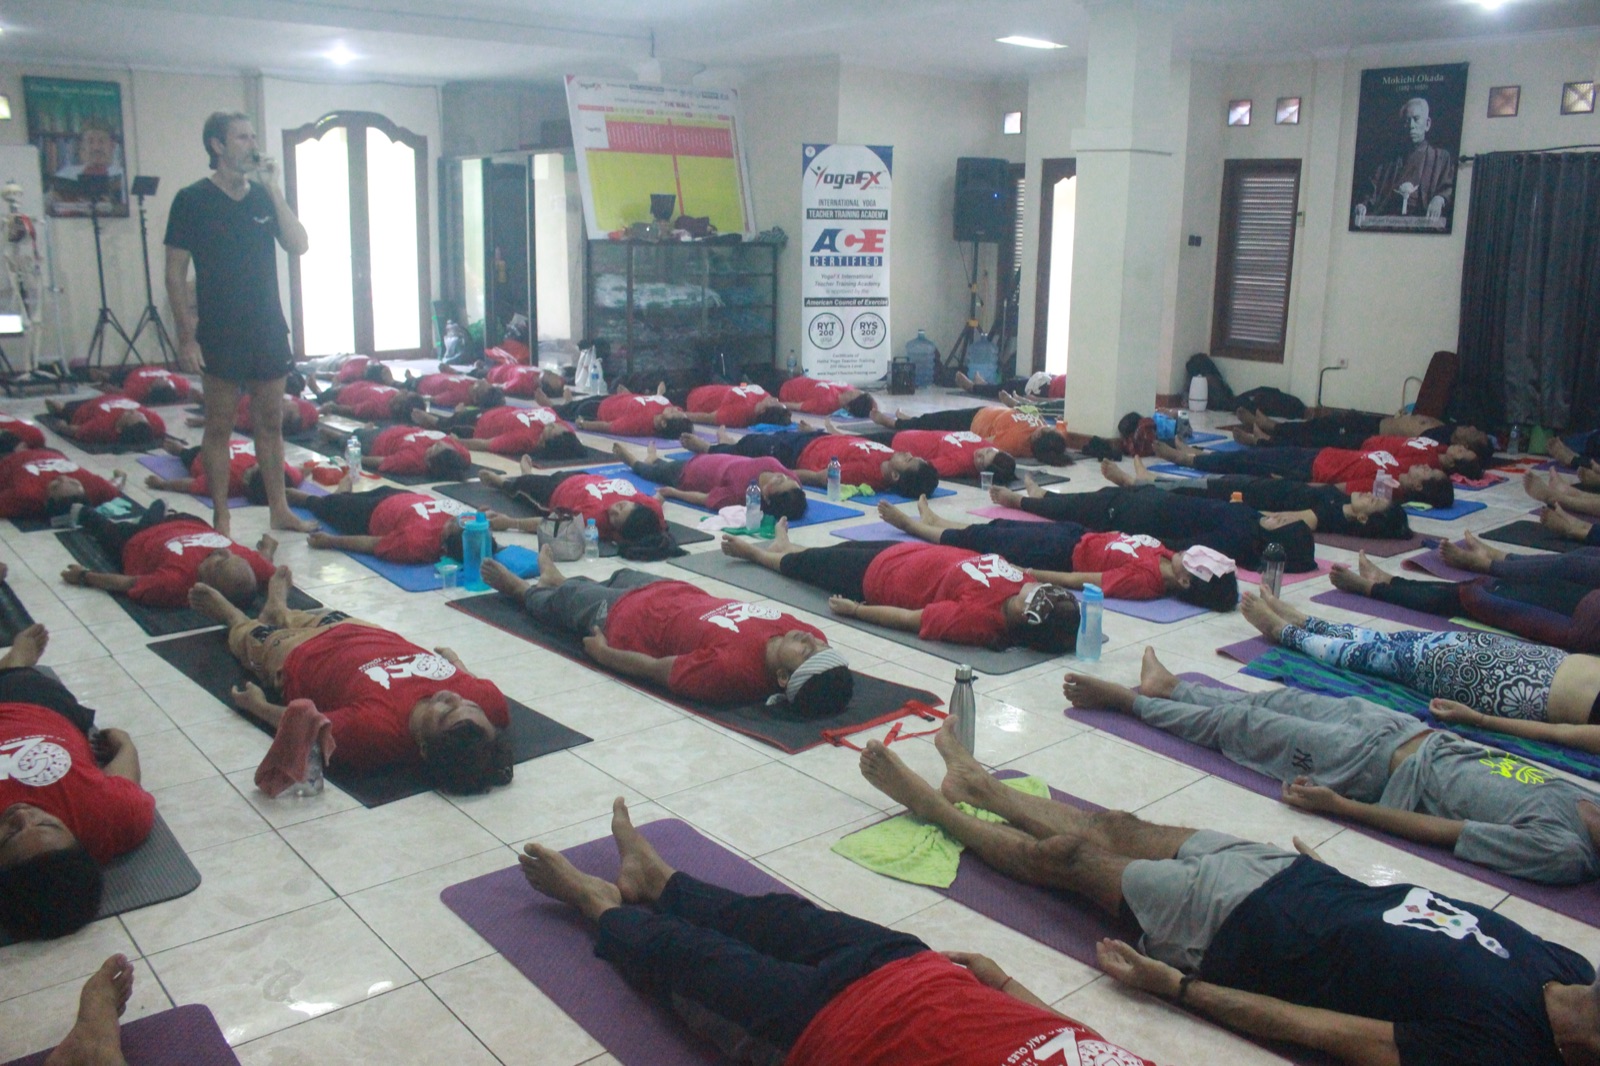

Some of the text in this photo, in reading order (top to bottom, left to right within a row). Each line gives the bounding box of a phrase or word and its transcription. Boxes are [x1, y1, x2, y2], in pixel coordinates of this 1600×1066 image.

[1382, 73, 1444, 84] Mokichi Okada
[809, 165, 882, 190] YogaFX
[818, 198, 876, 207] INTERNATIONAL YOGA
[809, 209, 886, 219] TEACHER TRAINING ACADEMY
[810, 228, 886, 253] ACE
[813, 256, 879, 266] CERTIFIED
[836, 280, 857, 288] Training
[857, 280, 881, 288] Academy
[817, 322, 836, 330] RYT
[859, 321, 878, 330] RYS
